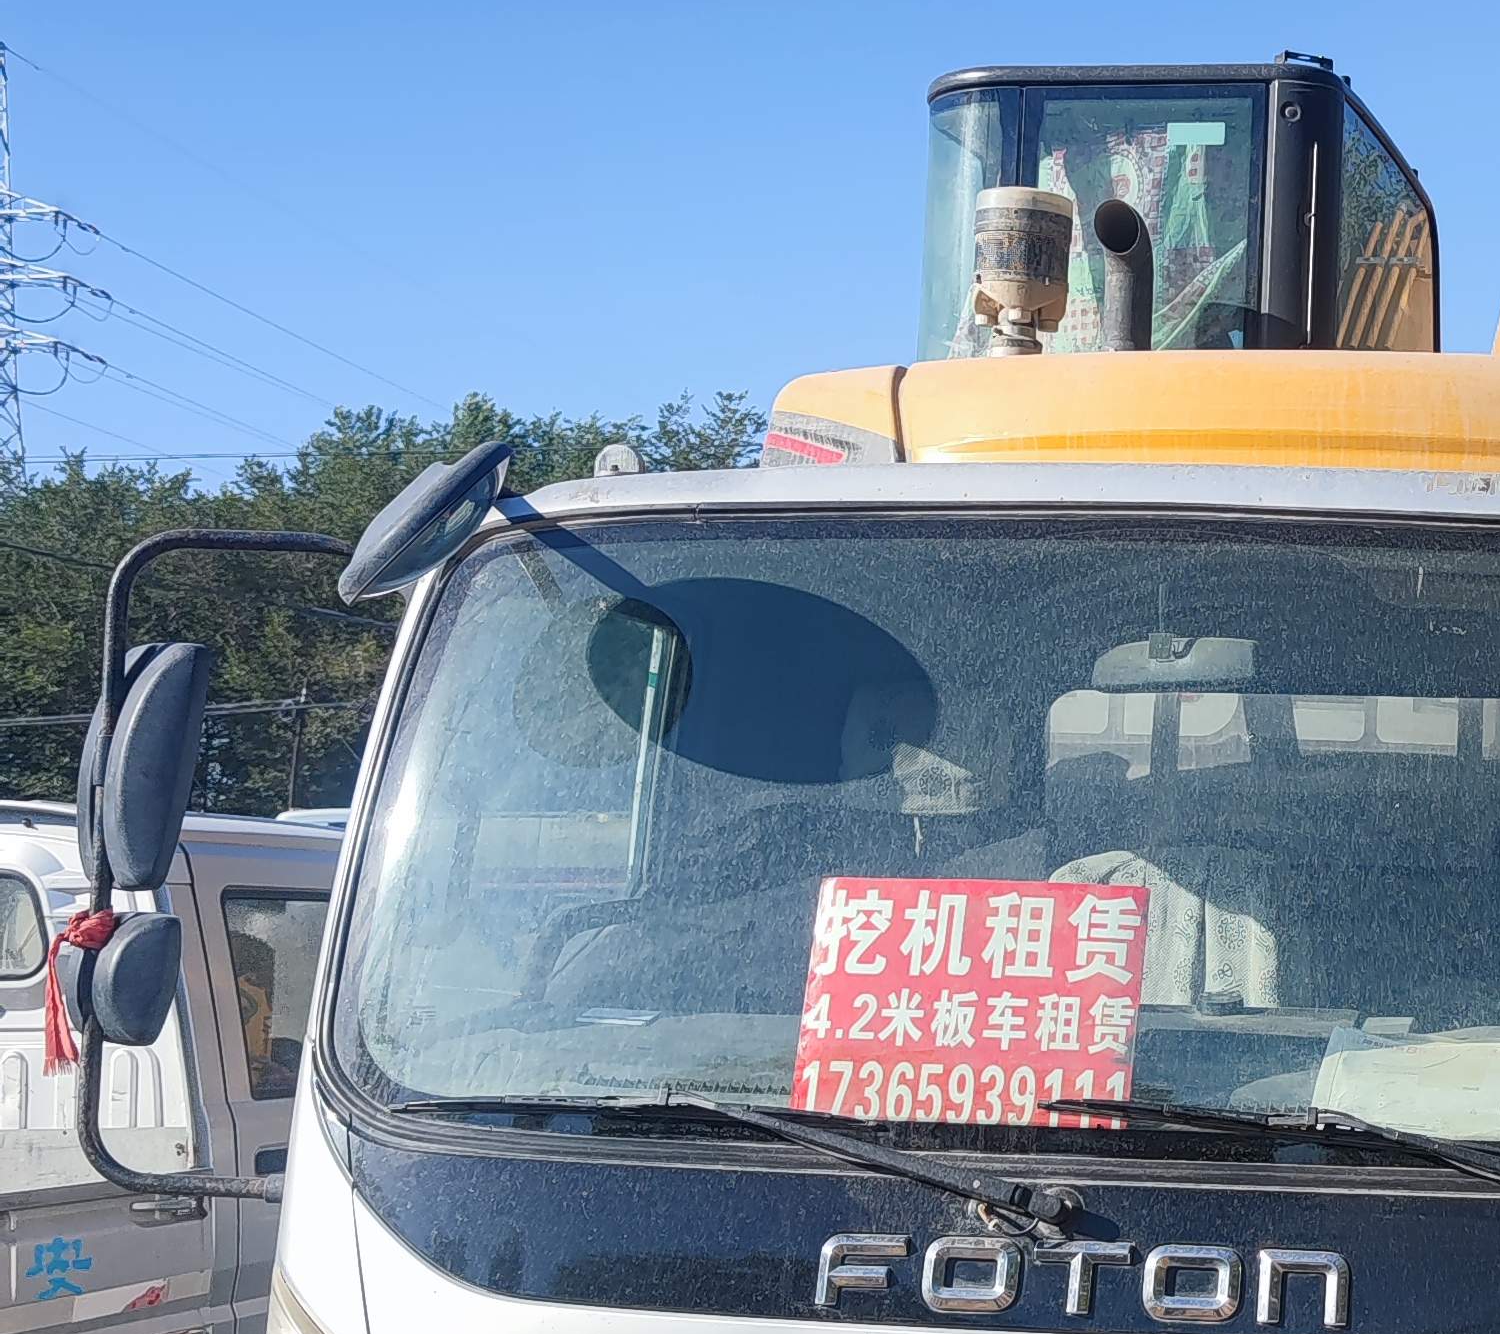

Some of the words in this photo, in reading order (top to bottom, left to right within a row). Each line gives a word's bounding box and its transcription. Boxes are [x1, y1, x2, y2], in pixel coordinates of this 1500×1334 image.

[814, 889, 1142, 985] 挖机租赁
[805, 988, 1136, 1055] 4.2米板车租赁
[802, 1060, 1126, 1129] 17365939111
[814, 1233, 1351, 1328] FOTON
